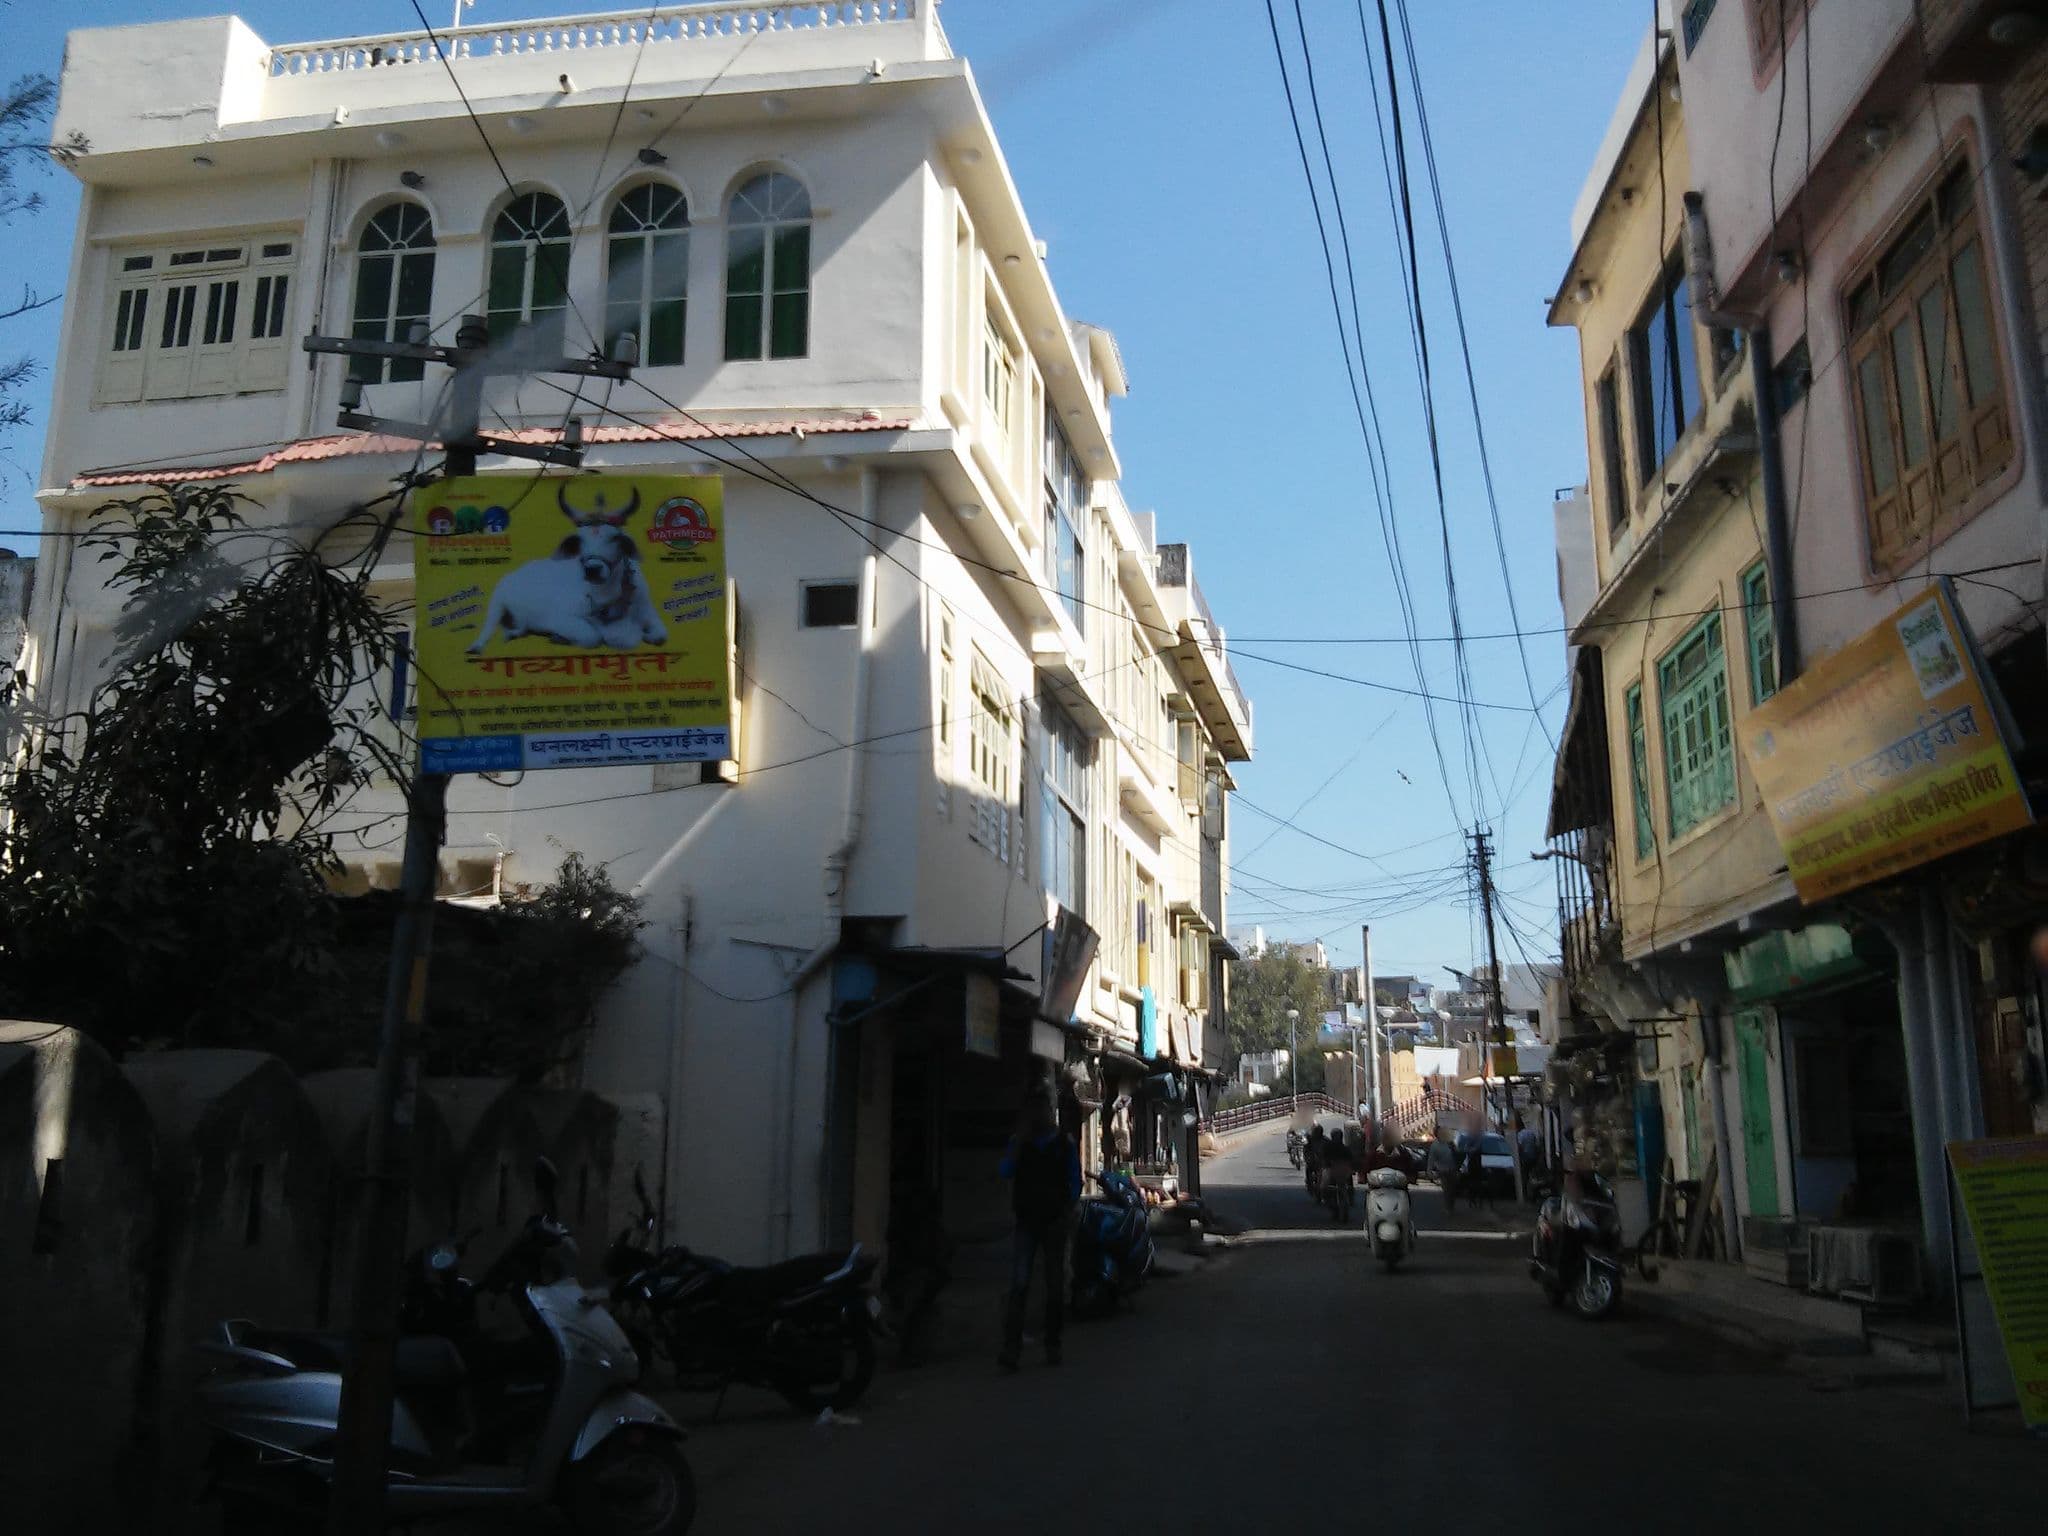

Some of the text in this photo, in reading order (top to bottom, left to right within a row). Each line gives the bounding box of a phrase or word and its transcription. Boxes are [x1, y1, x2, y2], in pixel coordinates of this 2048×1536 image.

[651, 529, 713, 541] PATHMEDA
[466, 652, 687, 680] गव्यामृत
[531, 732, 611, 754] धनलक्ष्मी
